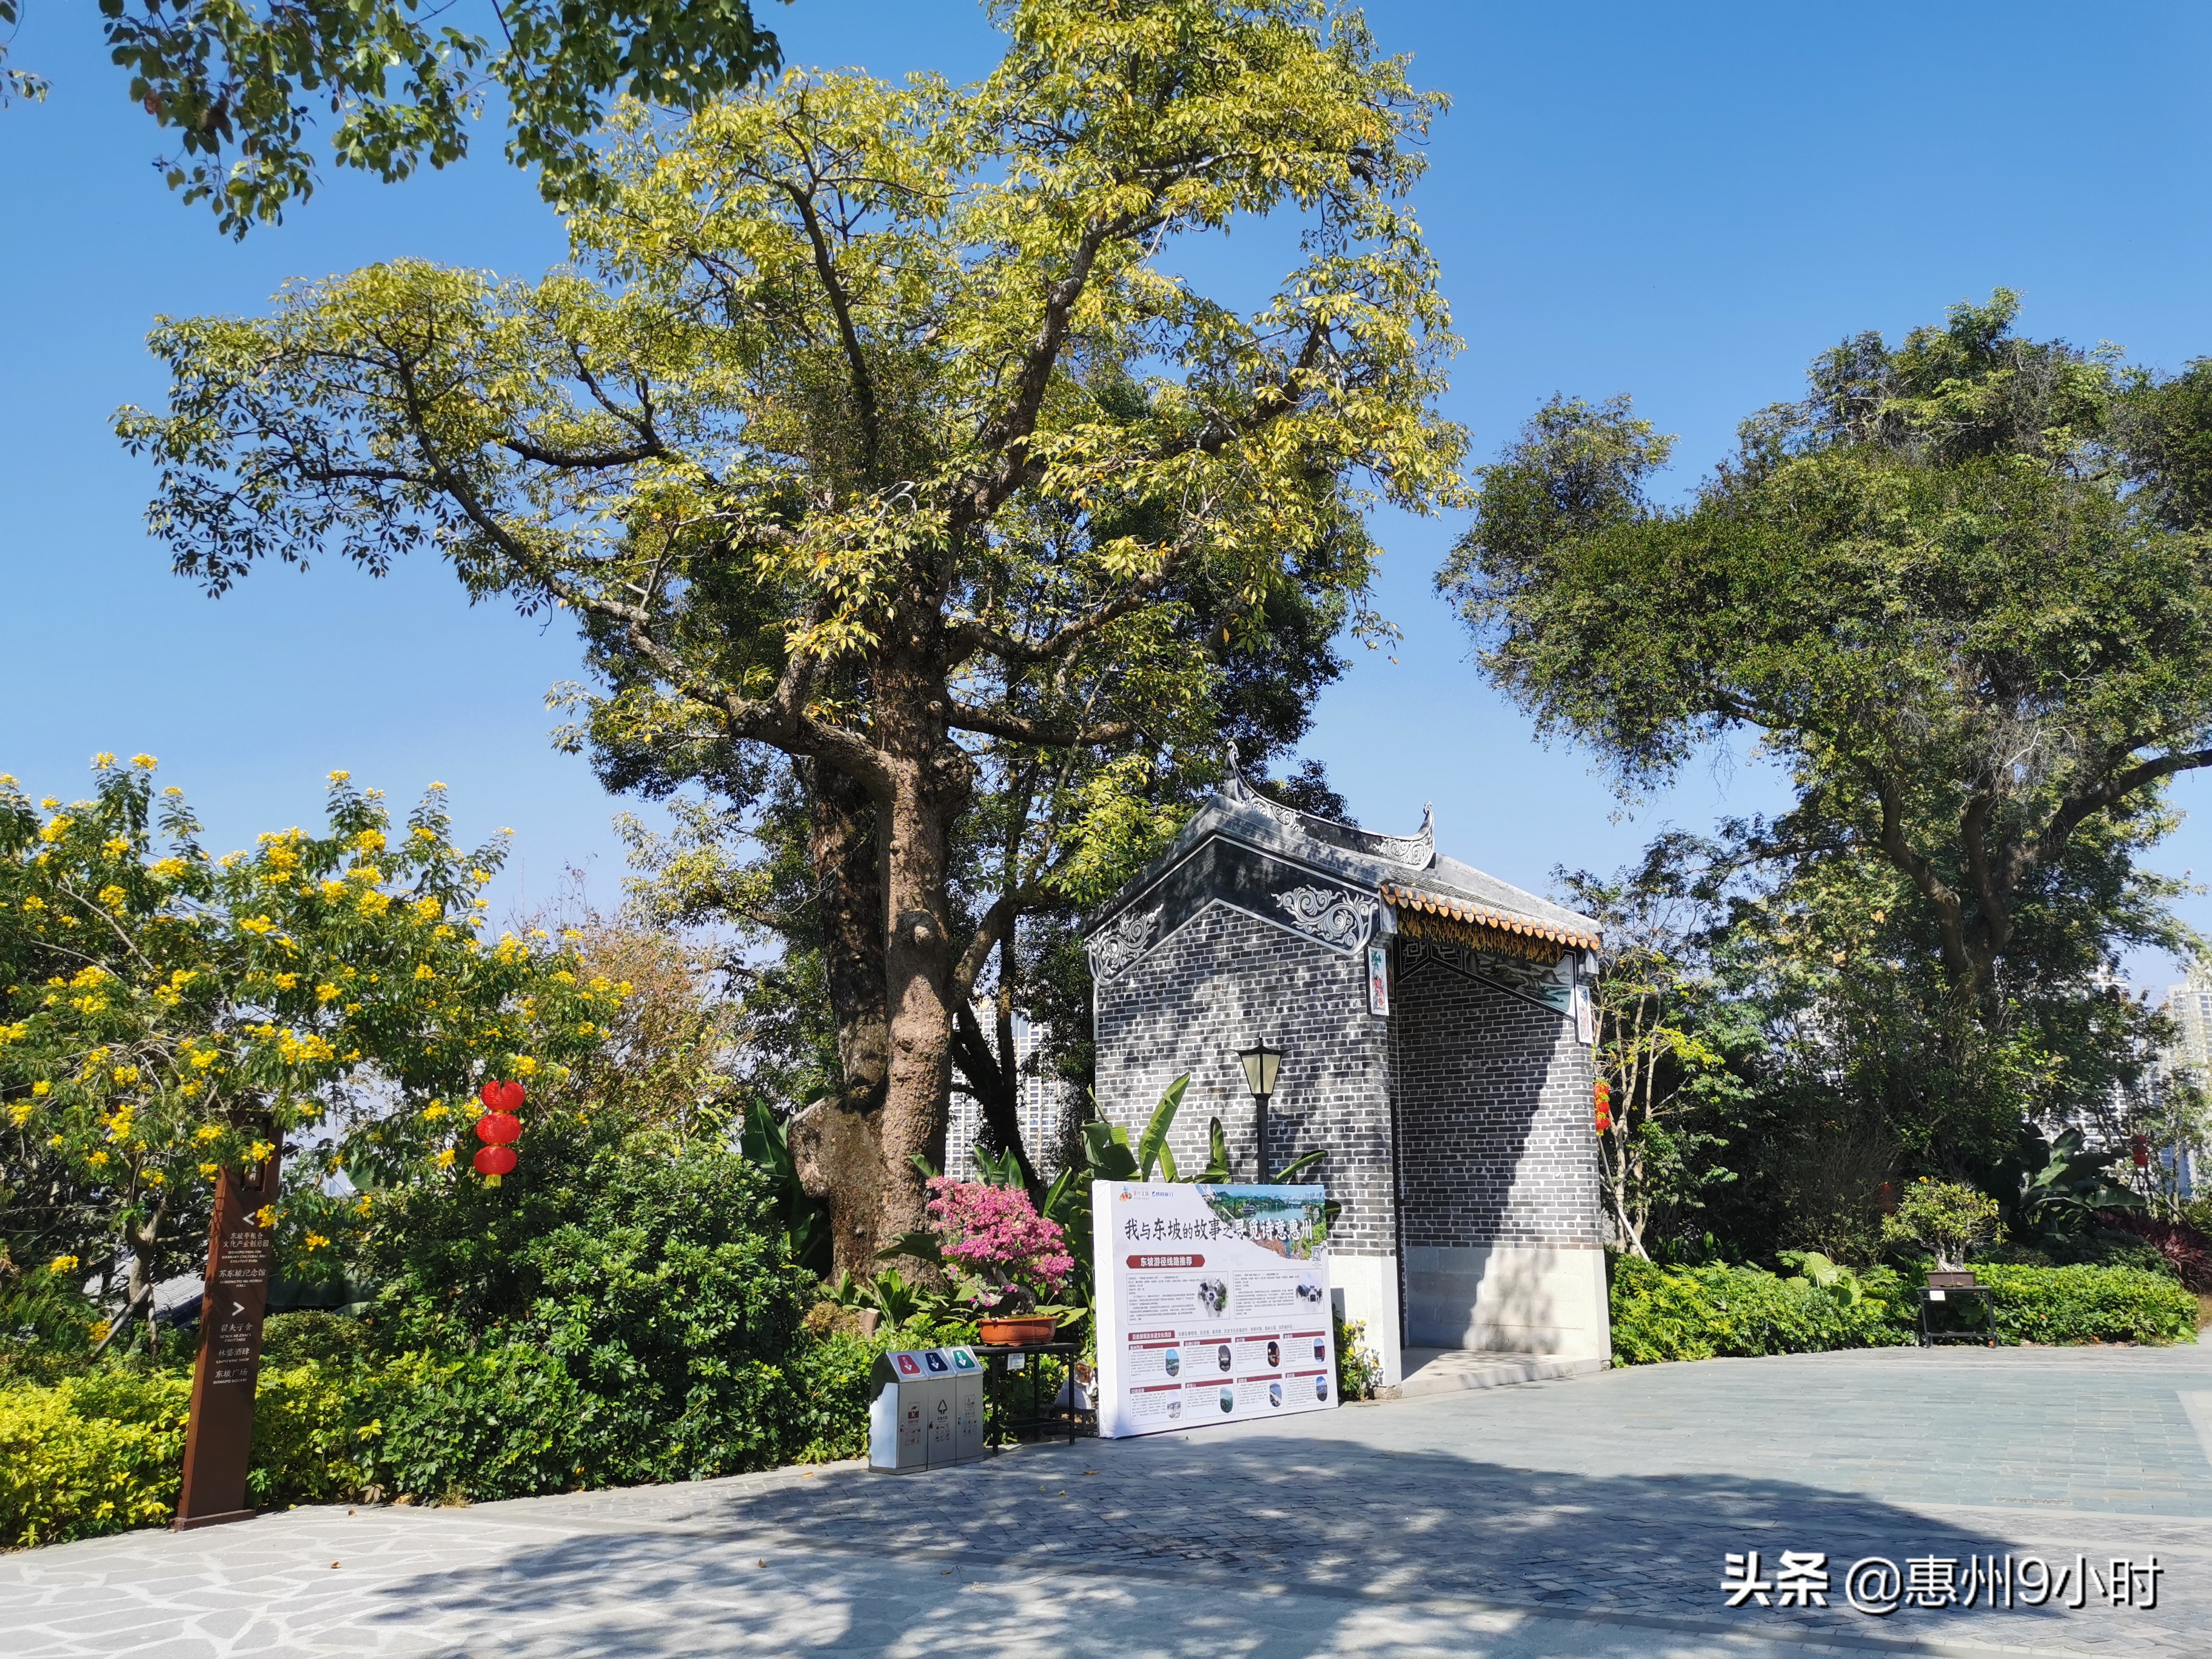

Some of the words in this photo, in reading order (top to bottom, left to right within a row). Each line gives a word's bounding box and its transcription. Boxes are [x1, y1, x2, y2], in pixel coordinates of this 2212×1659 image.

[1124, 1217, 1313, 1241] 我与东坡的故事之寻觅诗意惠州
[1140, 1256, 1193, 1267] 东坡游径线路推荐
[219, 1269, 266, 1278] 苏东坡纪念馆
[221, 1322, 252, 1332] 翟夫子舍
[218, 1347, 250, 1357] 林婆酒肆
[215, 1369, 248, 1378] 东坡广场
